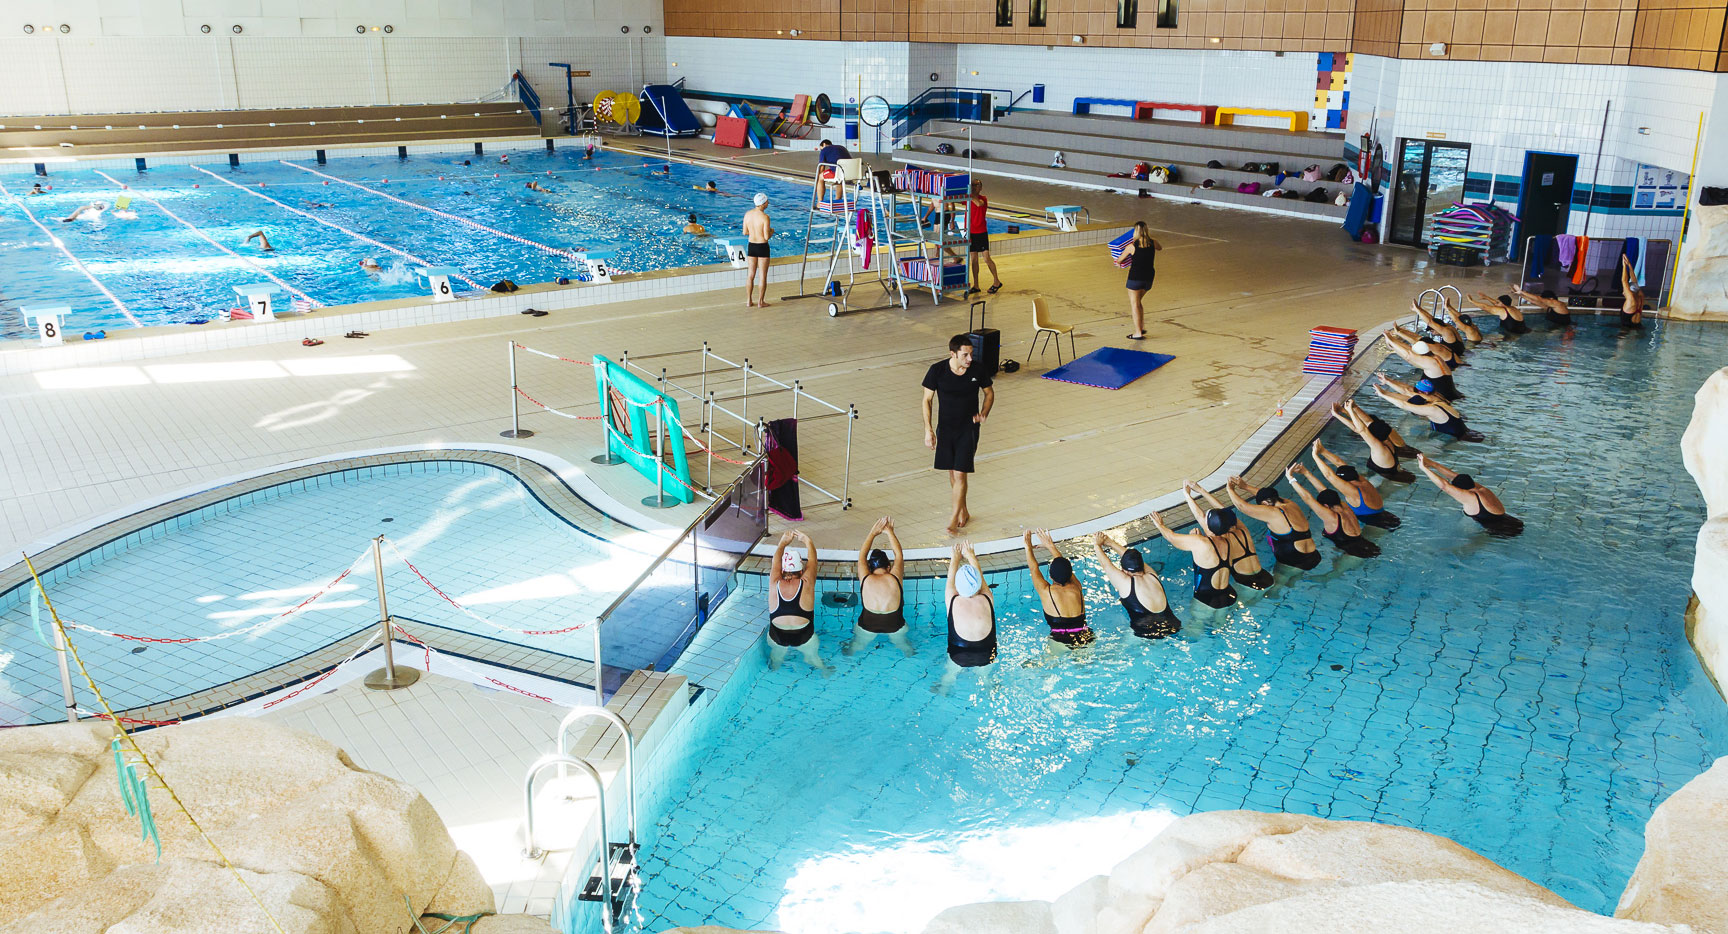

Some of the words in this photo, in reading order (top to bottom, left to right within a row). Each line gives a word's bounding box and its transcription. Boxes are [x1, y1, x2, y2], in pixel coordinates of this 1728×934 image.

[738, 250, 746, 262] 4
[597, 264, 607, 277] 5
[440, 281, 449, 295] 6
[257, 300, 266, 315] 7
[44, 322, 56, 338] 8
